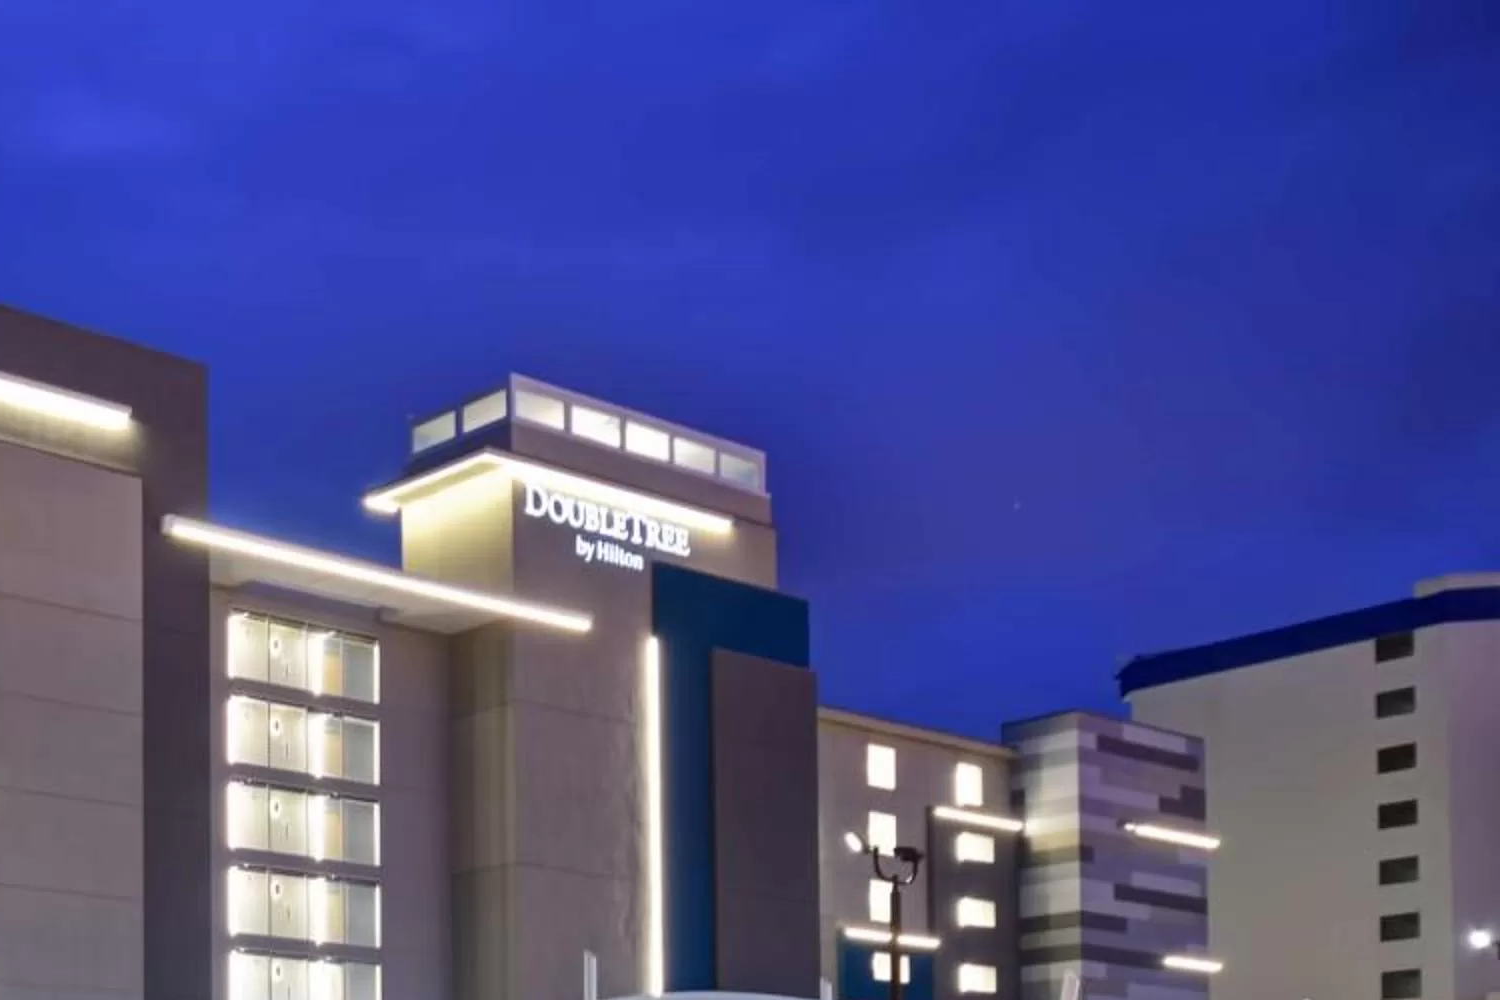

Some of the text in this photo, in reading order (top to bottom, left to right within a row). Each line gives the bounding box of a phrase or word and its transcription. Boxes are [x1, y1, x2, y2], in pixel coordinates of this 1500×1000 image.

[524, 483, 691, 557] DOUBLETREE
[575, 534, 644, 571] by Hilton
